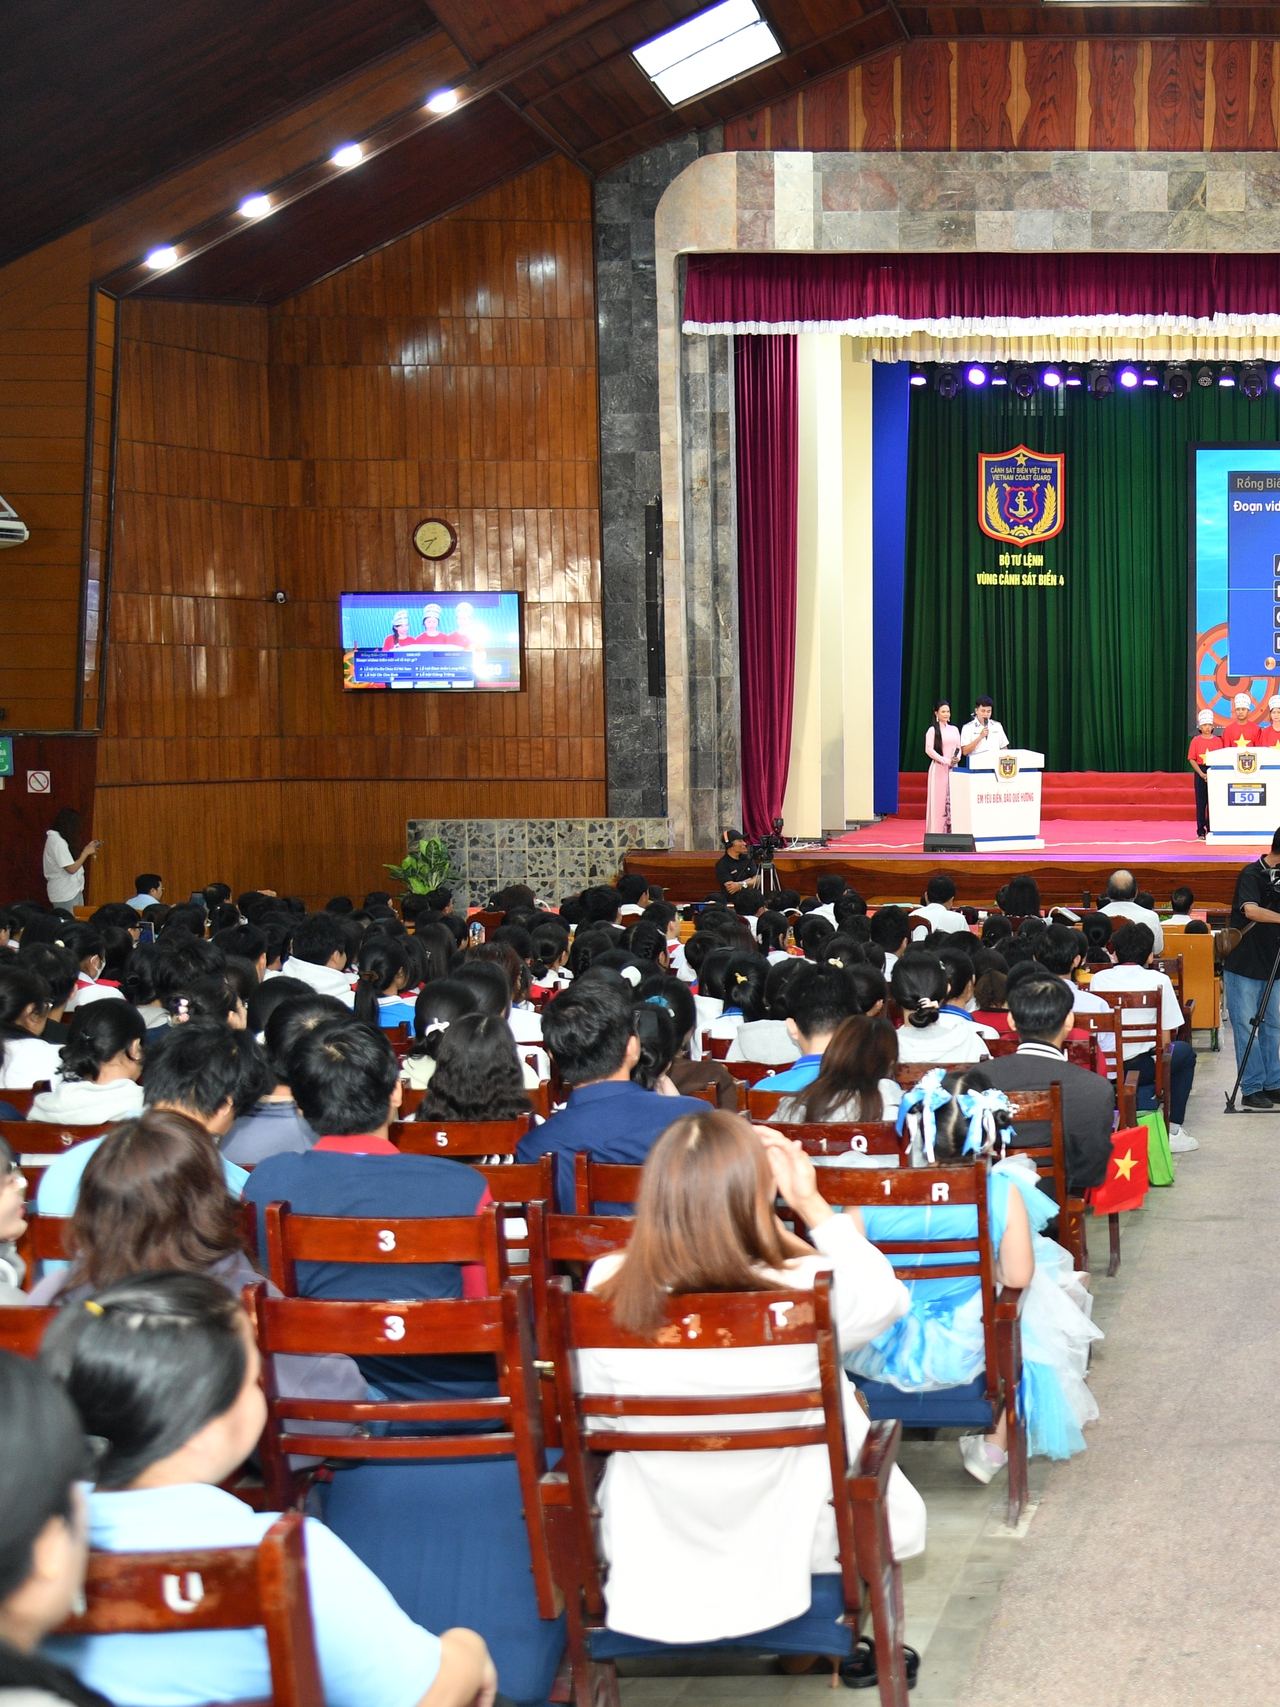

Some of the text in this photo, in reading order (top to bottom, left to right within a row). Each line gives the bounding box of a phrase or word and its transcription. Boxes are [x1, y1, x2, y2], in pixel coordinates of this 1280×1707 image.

[1237, 476, 1264, 490] Rồng
[1233, 500, 1262, 514] Đoạn
[999, 552, 1044, 568] BỘ TƯ LỆNH
[977, 570, 1064, 586] VÙNG CẢNH SÁT BIỂN 4
[1240, 793, 1254, 802] 50
[1090, 1019, 1098, 1029] L
[436, 1132, 448, 1147] 5
[820, 1135, 868, 1153] 1 Q
[881, 1180, 950, 1202] 1 R
[378, 1230, 396, 1252] 3
[768, 1301, 794, 1327] T
[384, 1315, 406, 1341] 3
[162, 1571, 204, 1614] U
